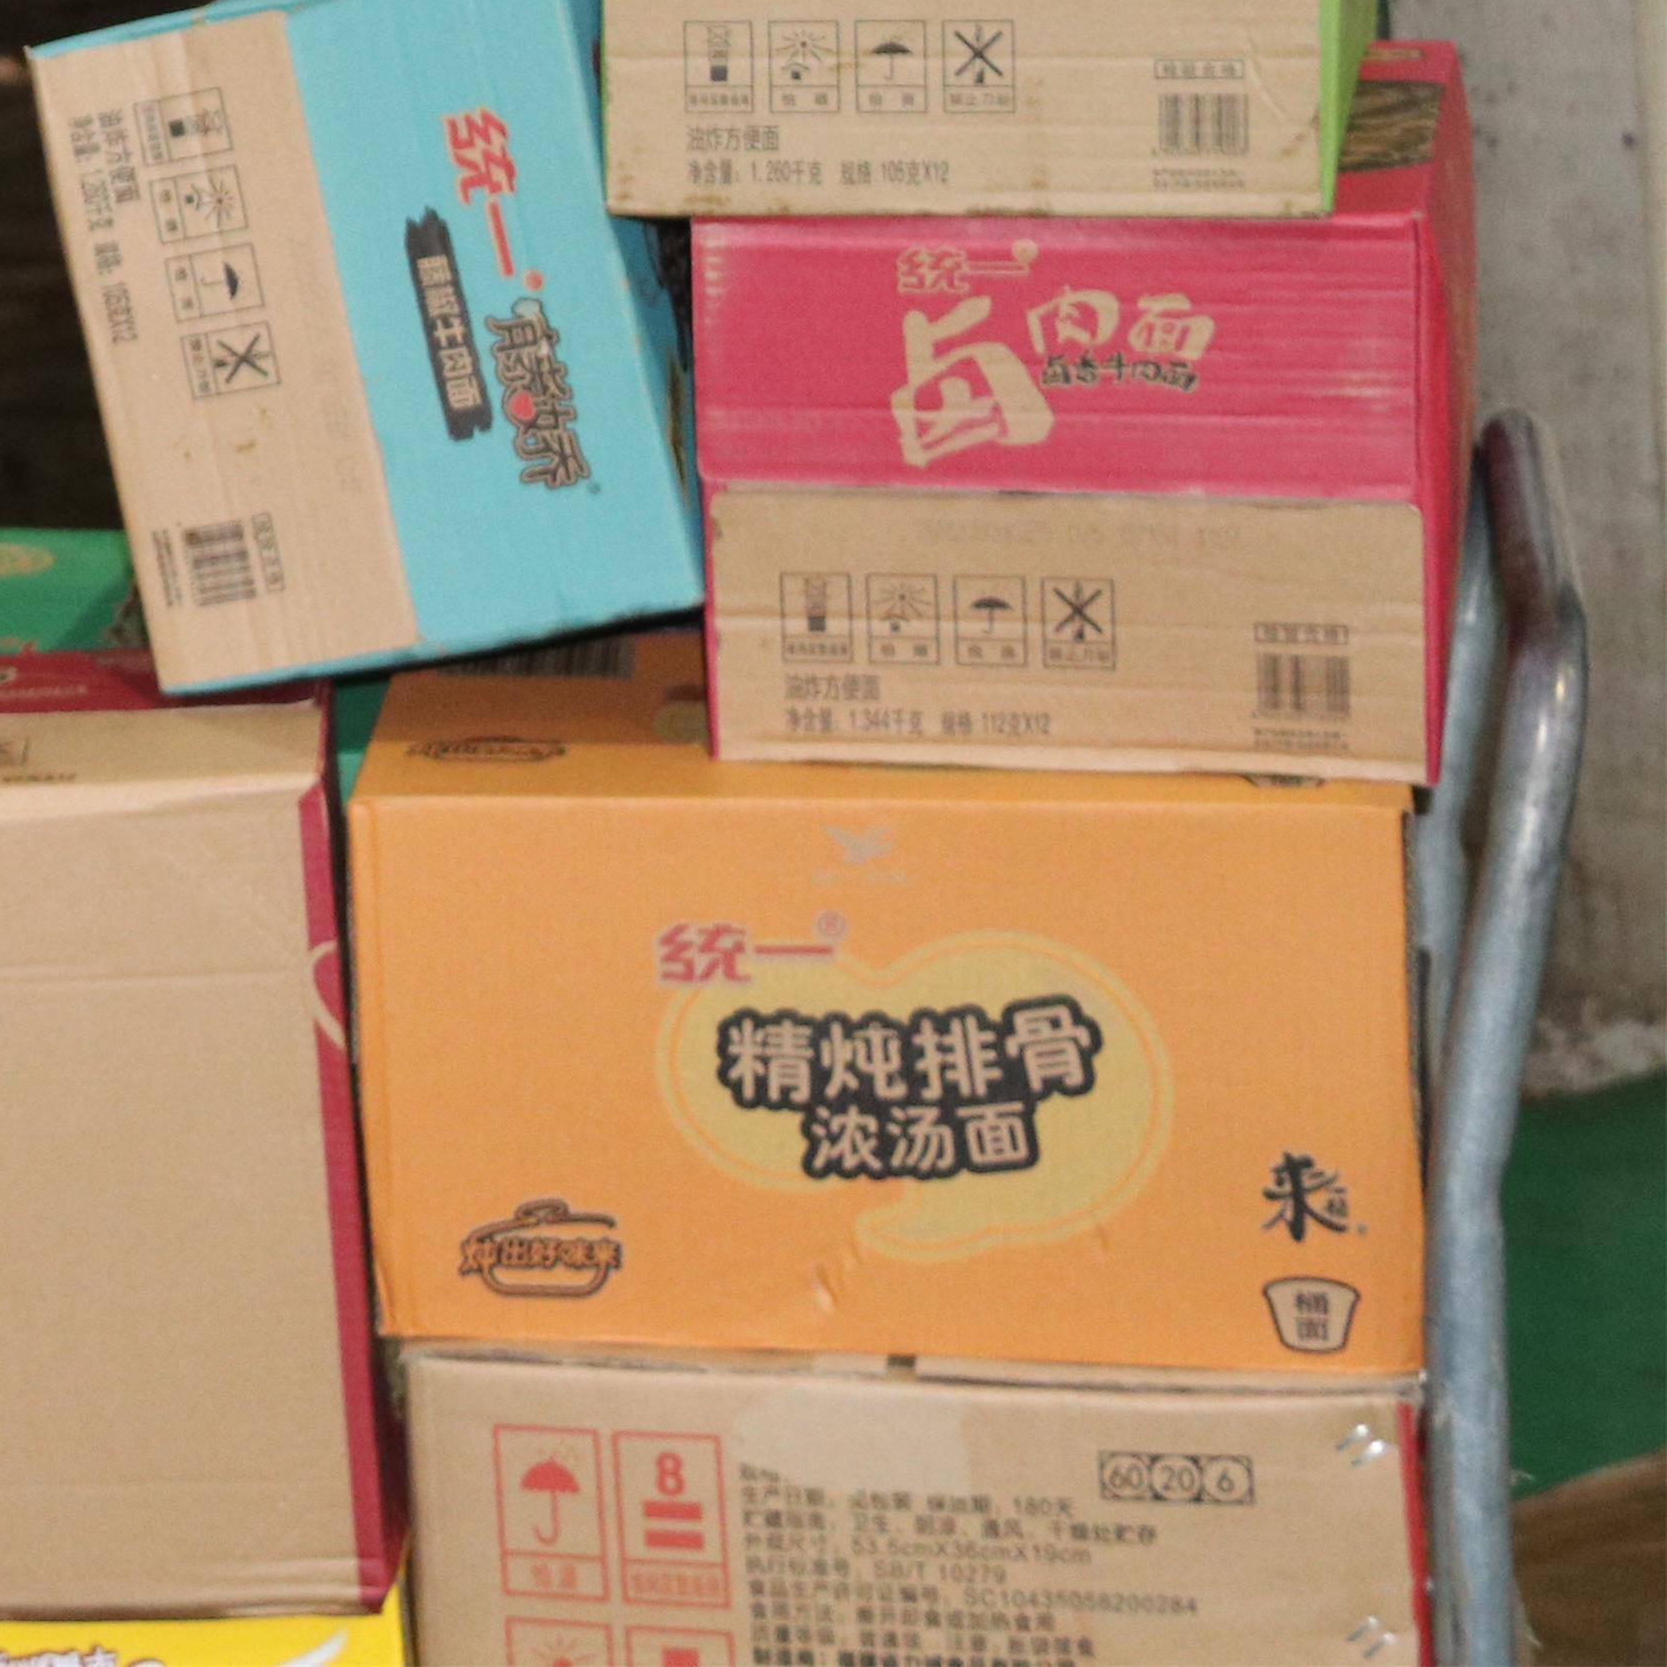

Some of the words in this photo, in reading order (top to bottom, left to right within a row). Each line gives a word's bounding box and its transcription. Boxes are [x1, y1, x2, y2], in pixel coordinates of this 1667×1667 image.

[442, 105, 518, 279] 统一
[896, 244, 1031, 294] 统一
[660, 923, 835, 983] 统一
[725, 1003, 1097, 1103] 精炖排骨
[810, 1100, 1030, 1173] 浓汤面
[656, 1451, 686, 1496] 8
